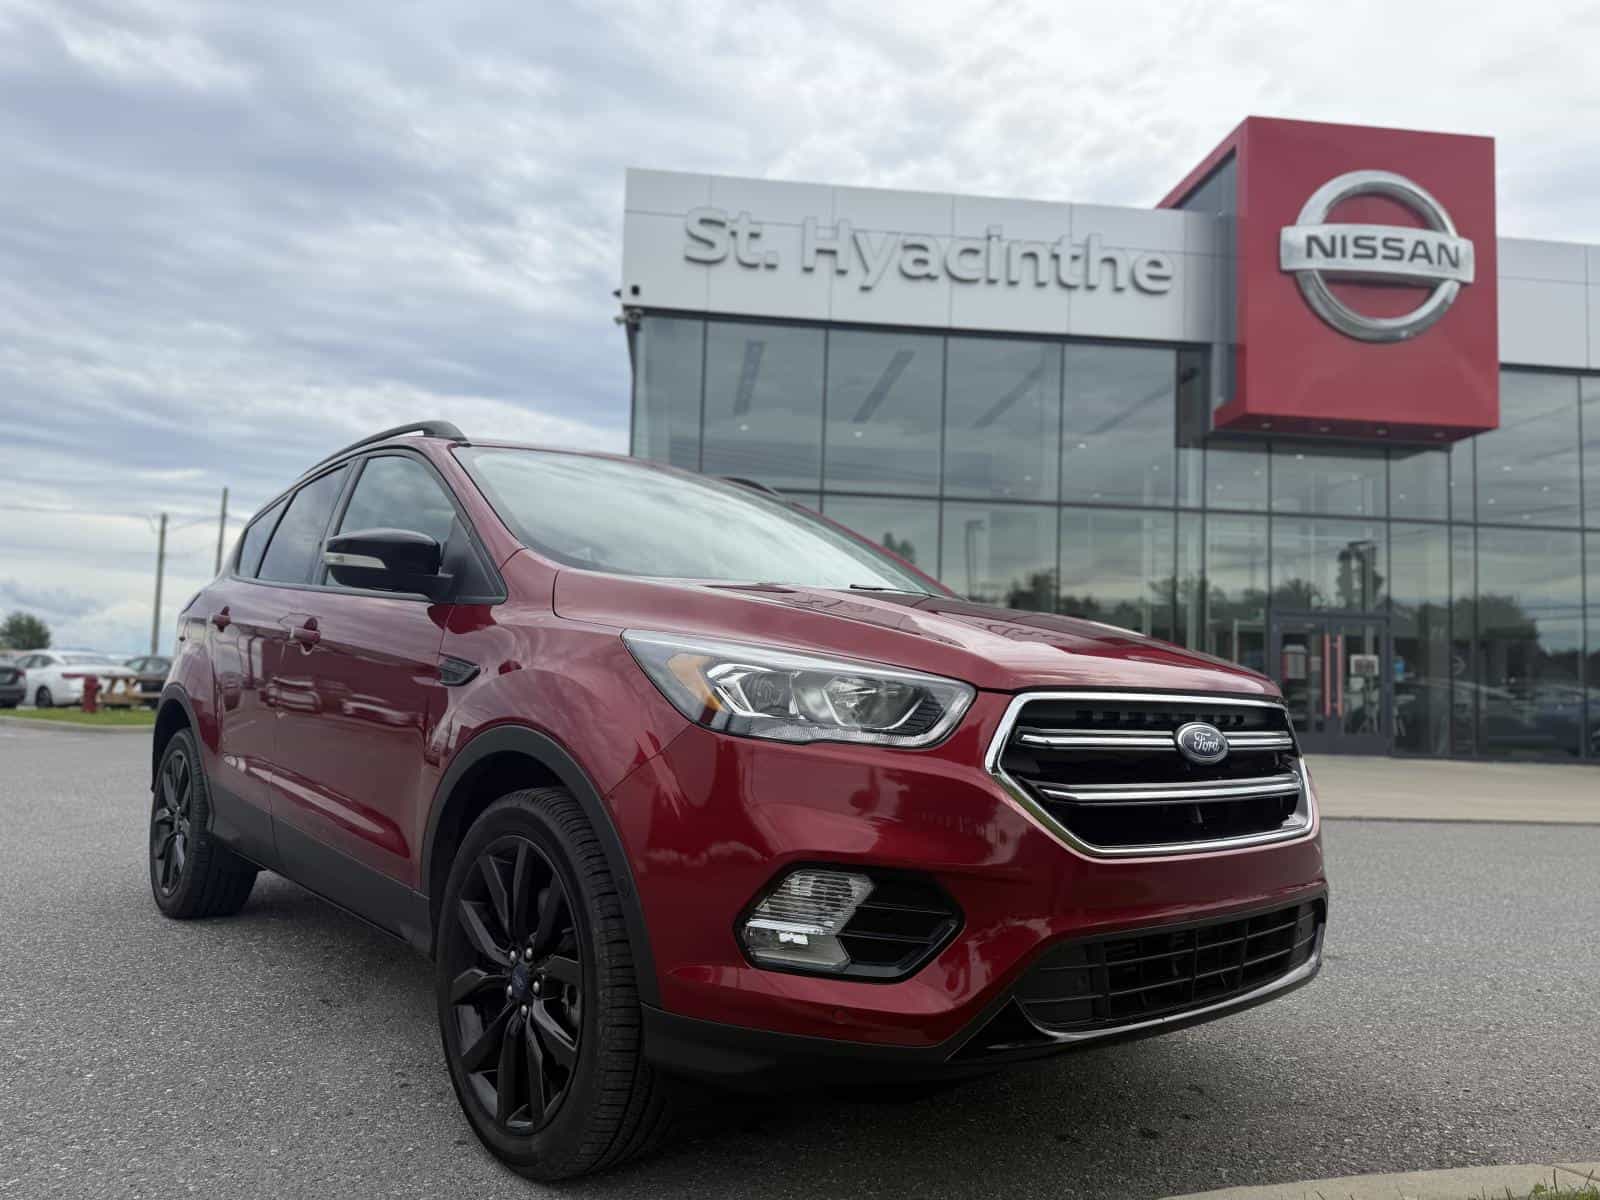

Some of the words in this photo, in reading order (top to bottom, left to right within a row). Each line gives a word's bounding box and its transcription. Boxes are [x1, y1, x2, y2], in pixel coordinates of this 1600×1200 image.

[684, 206, 778, 270] St.
[802, 217, 1173, 295] Hyacinthe
[1306, 235, 1459, 268] NISSAN
[1194, 731, 1219, 752] Ford
